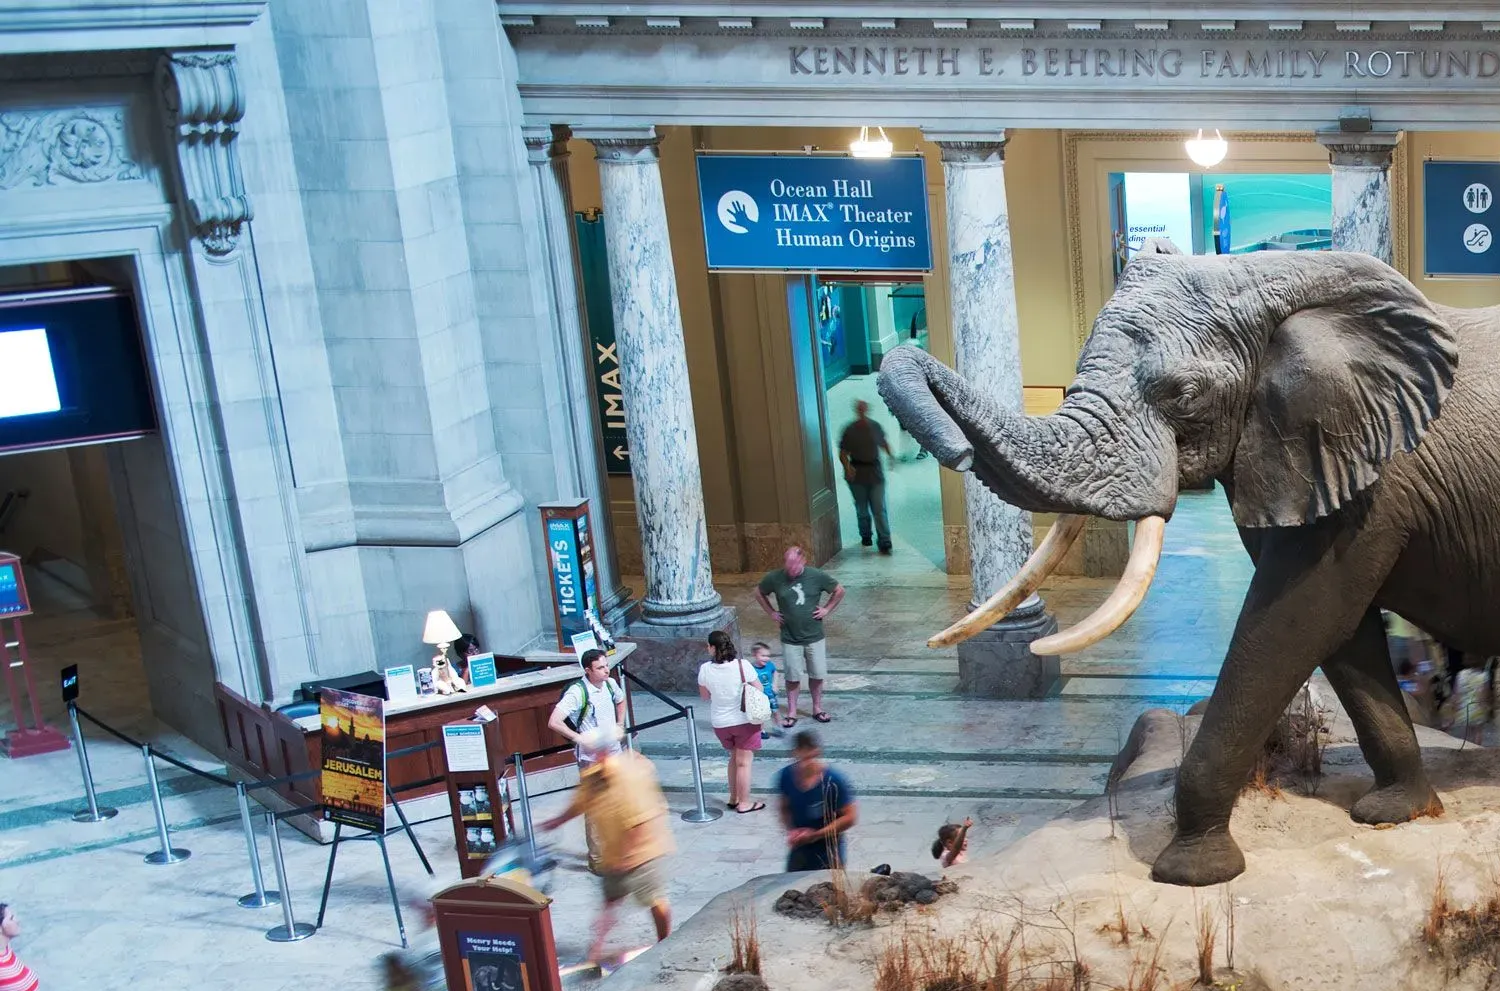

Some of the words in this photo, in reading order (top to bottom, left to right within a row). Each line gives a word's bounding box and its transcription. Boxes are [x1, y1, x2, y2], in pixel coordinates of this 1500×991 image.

[788, 46, 961, 76] KENNETH
[978, 47, 1004, 77] E.
[1021, 48, 1183, 79] BEHRING
[1200, 49, 1329, 79] FAMILY
[770, 179, 827, 198] Ocean
[832, 179, 873, 198] Hall
[839, 204, 913, 224] Theater
[1129, 224, 1166, 233] essential
[776, 228, 844, 247] Human
[849, 229, 916, 253] Origins
[597, 342, 626, 428] IMAX
[554, 539, 577, 615] TICKETS
[324, 758, 382, 780] JERUSALEM
[466, 937, 491, 946] Henry
[492, 946, 513, 954] Help!
